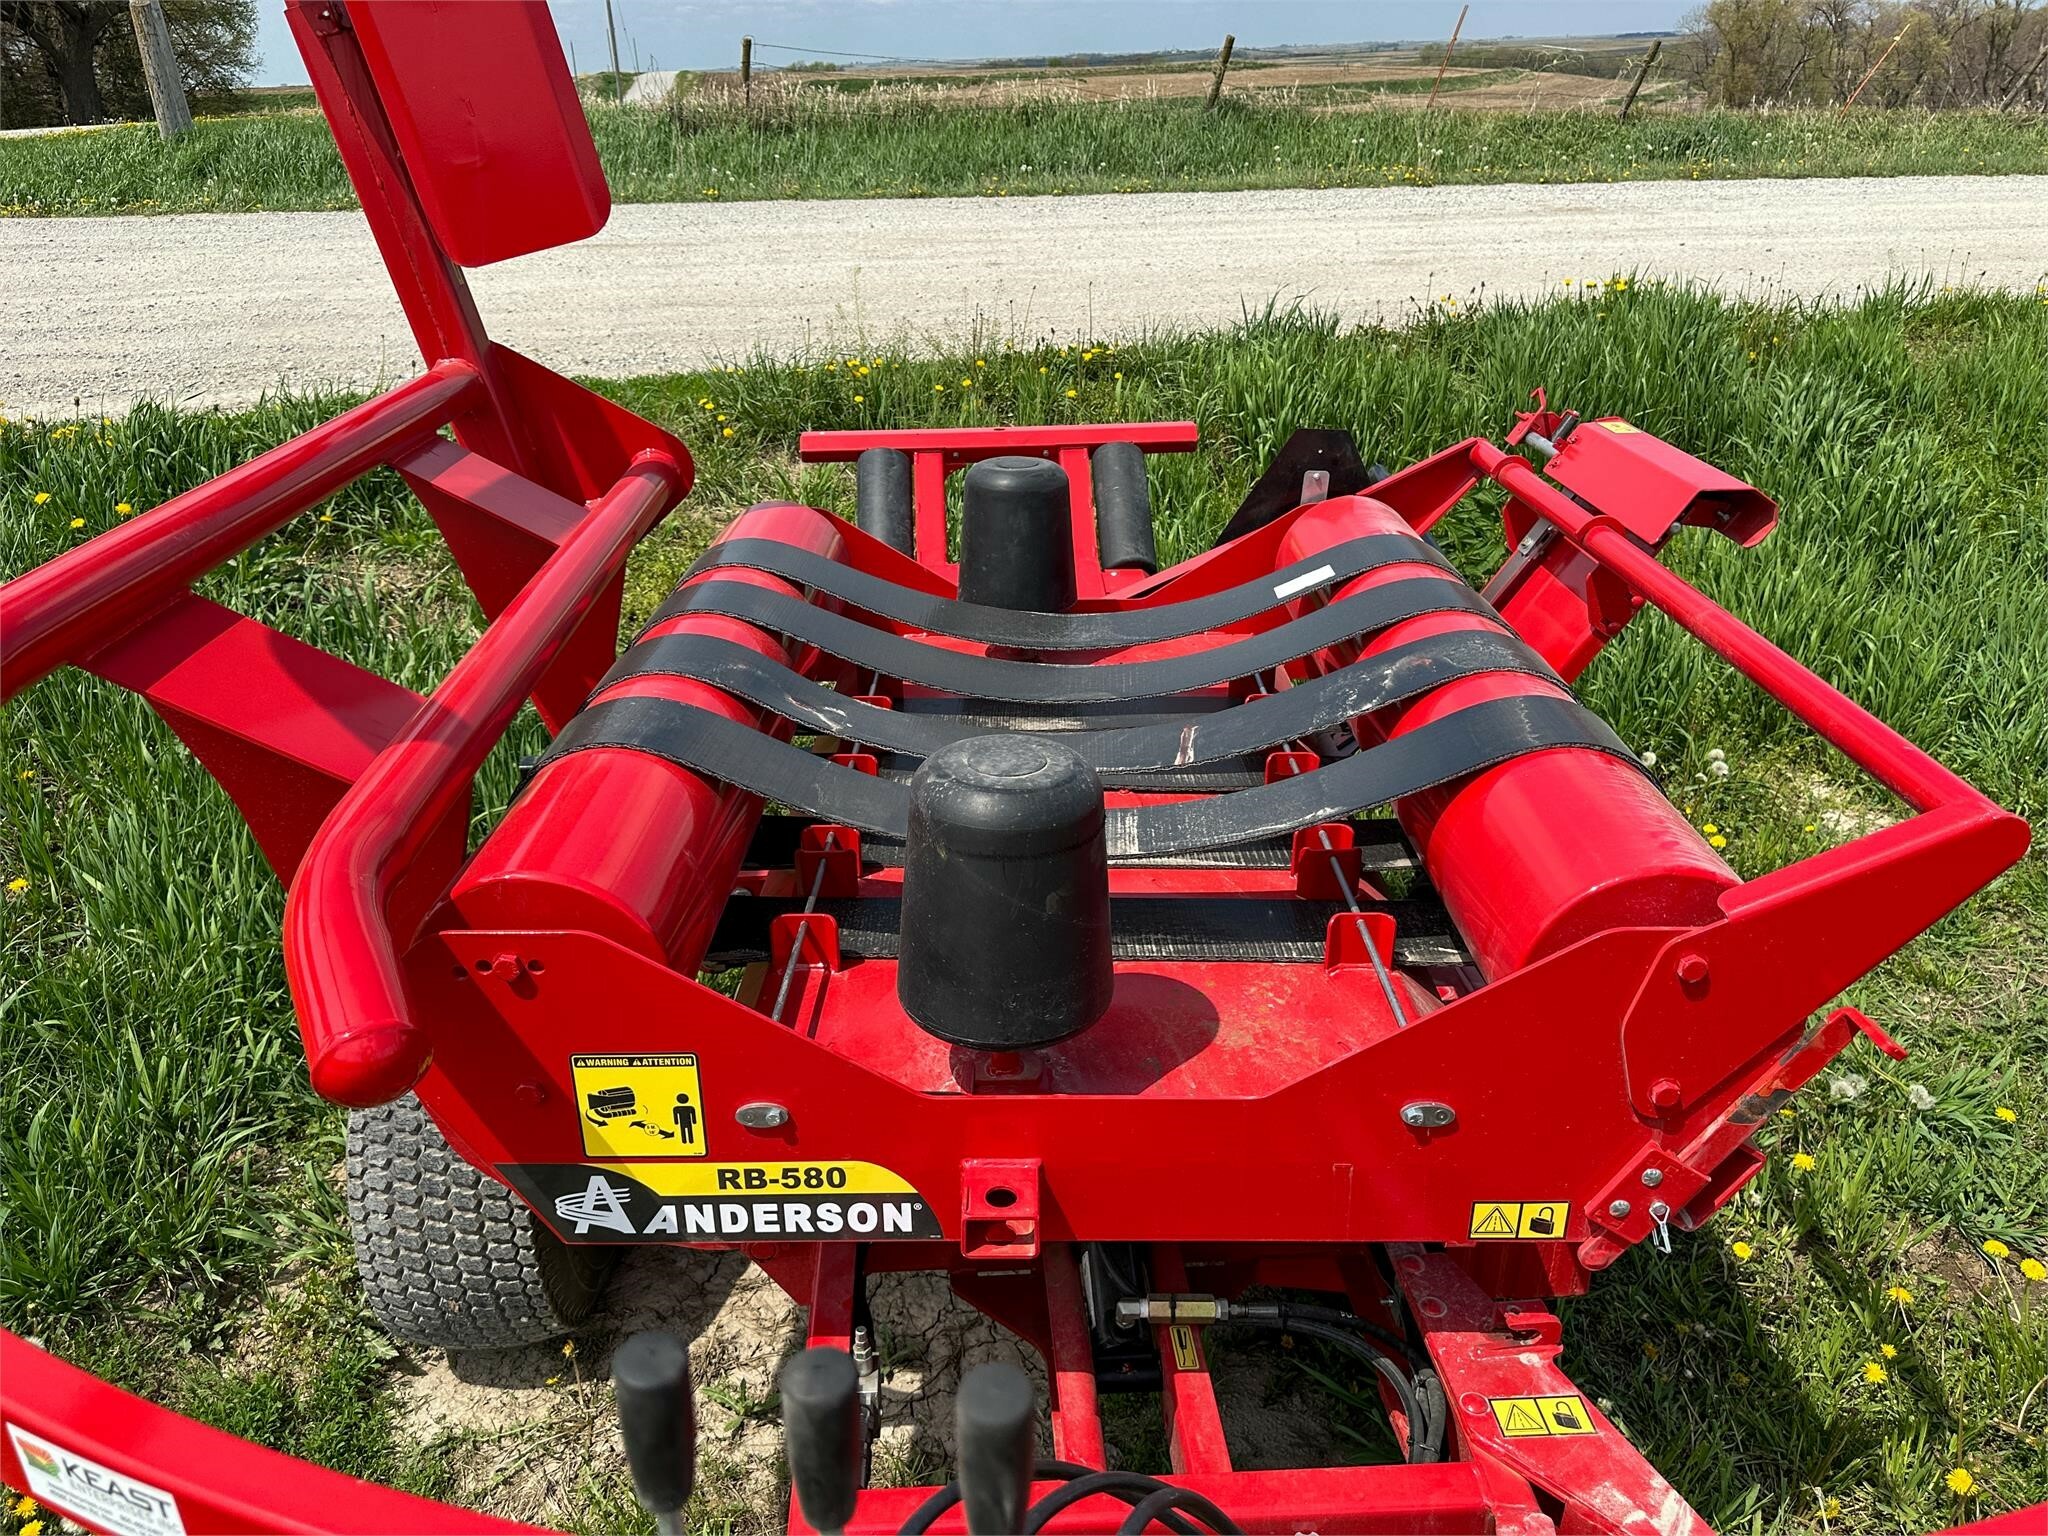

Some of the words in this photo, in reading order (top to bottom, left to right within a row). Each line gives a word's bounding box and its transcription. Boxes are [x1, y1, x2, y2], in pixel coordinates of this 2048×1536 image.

[586, 1058, 629, 1066] WARNING
[643, 1057, 692, 1066] ATTENTION
[718, 1167, 847, 1189] RB-580
[61, 1458, 171, 1518] KEAST
